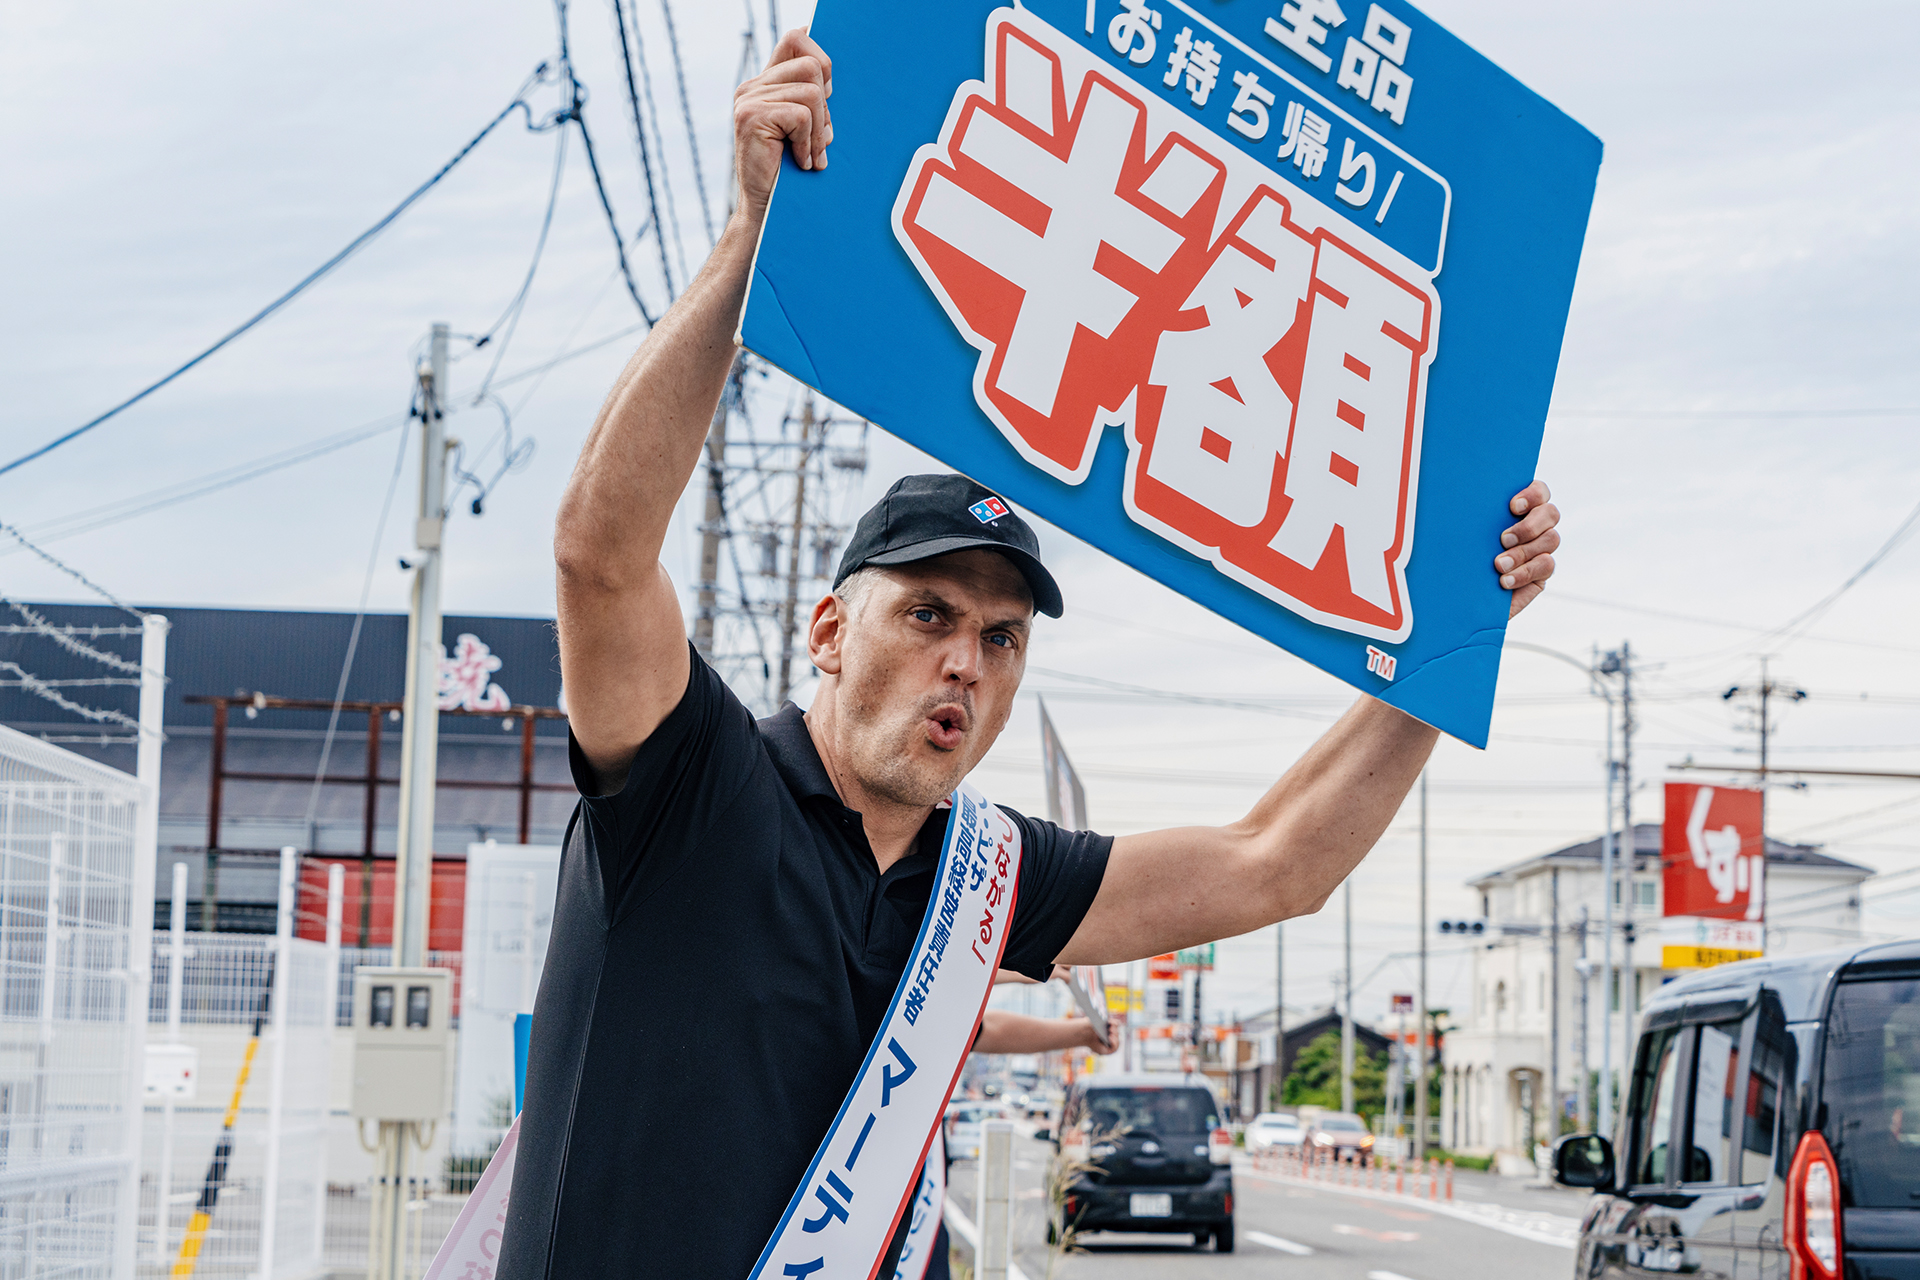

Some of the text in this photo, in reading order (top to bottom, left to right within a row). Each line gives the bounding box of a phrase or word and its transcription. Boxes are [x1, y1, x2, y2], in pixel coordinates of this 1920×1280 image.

[1107, 0, 1377, 207] お持ち帰り
[1264, 0, 1414, 125] 全品
[906, 22, 1432, 624] 半額
[1367, 646, 1396, 680] TM
[903, 792, 978, 1027] 最高経営責任者
